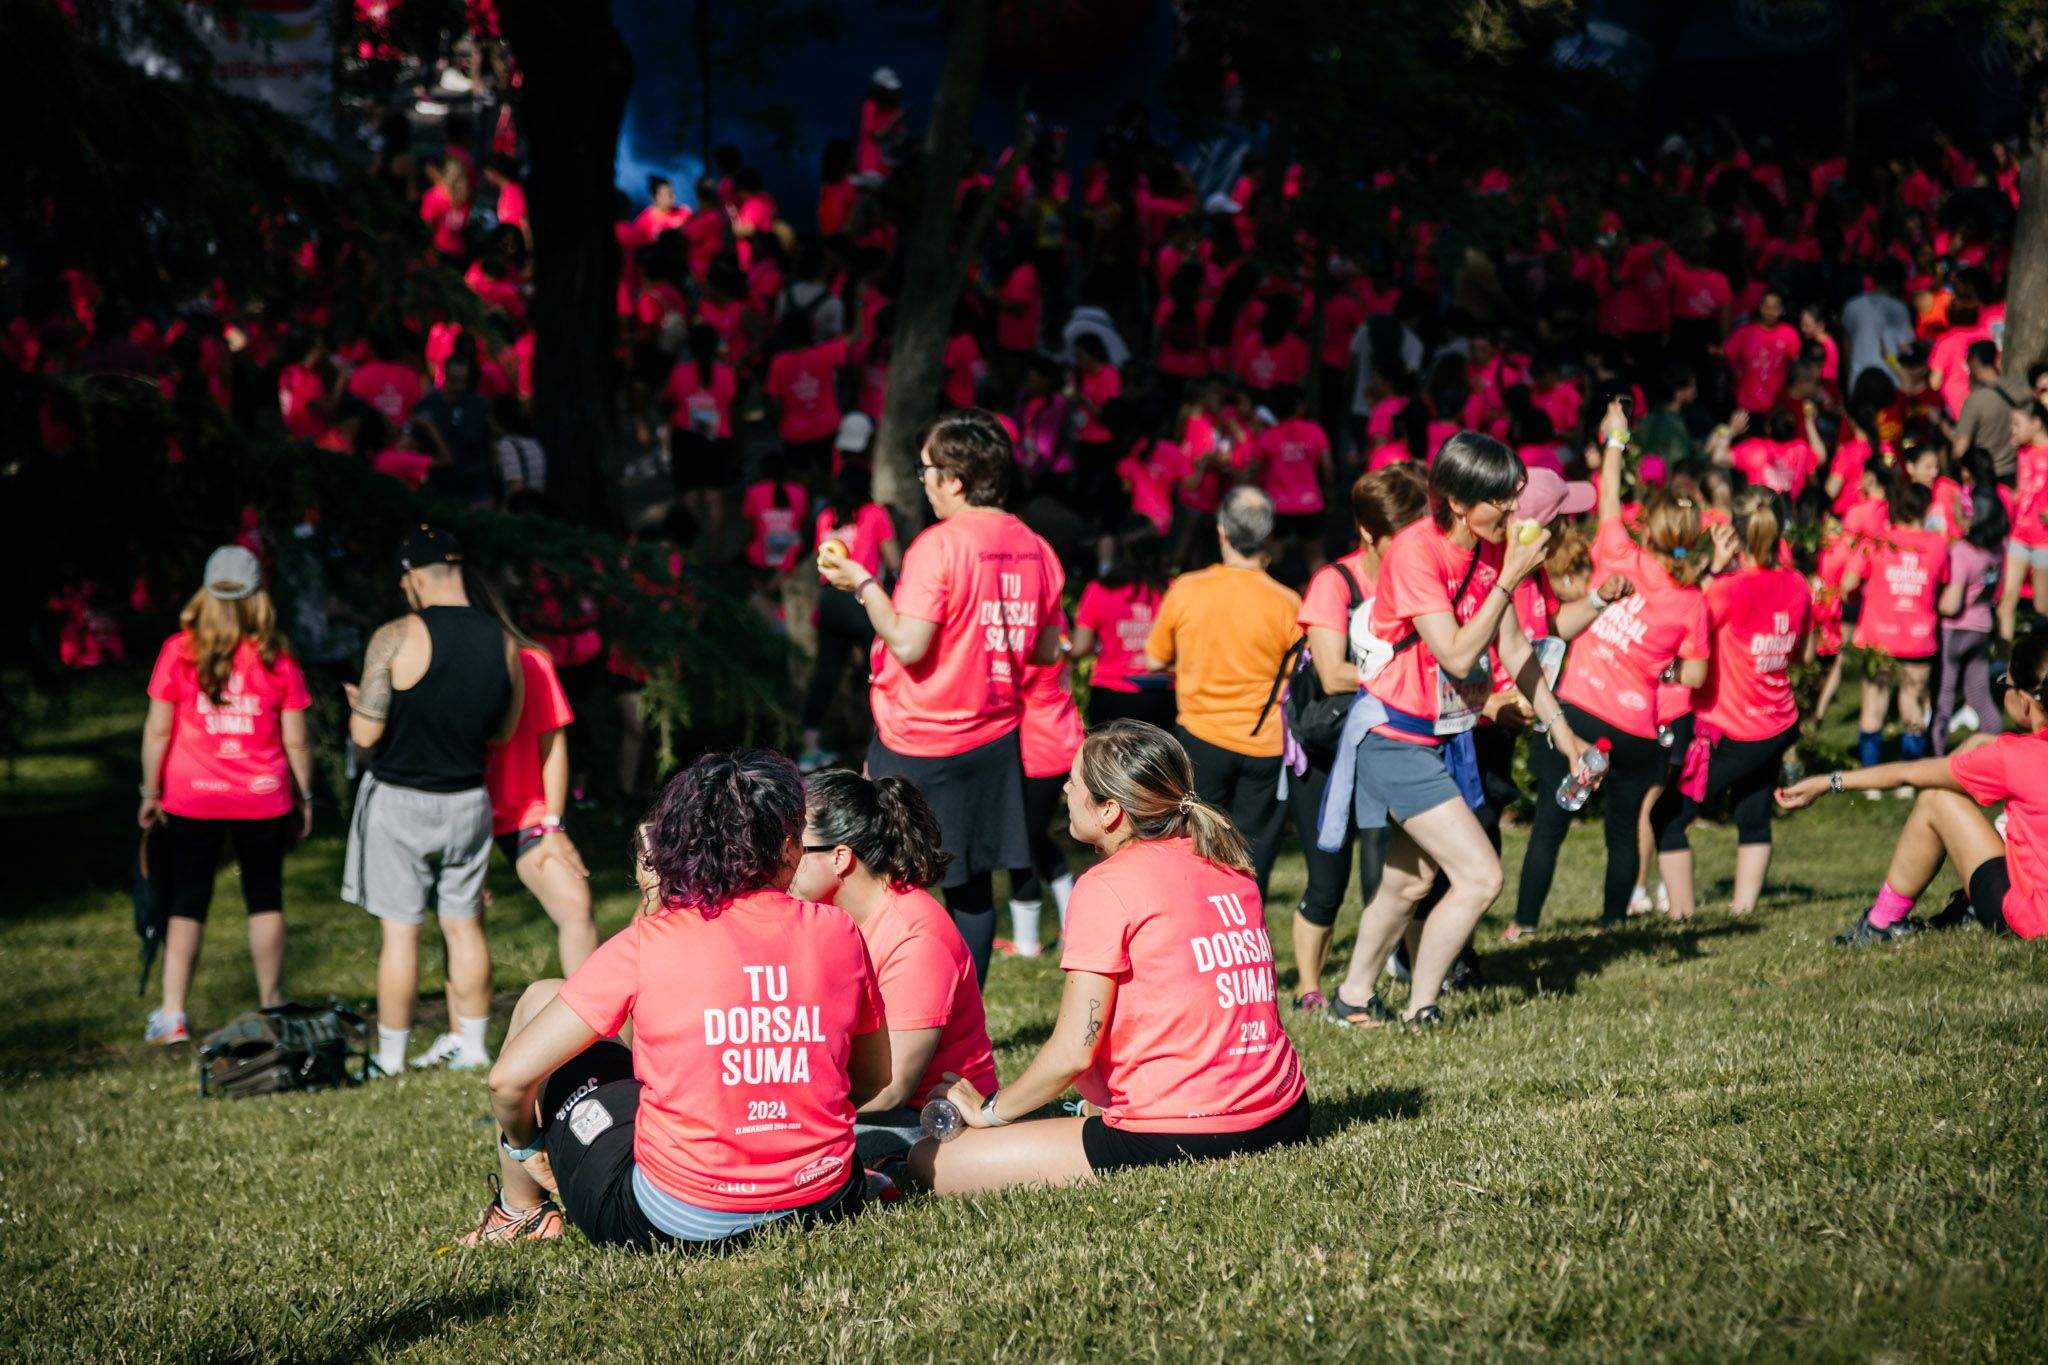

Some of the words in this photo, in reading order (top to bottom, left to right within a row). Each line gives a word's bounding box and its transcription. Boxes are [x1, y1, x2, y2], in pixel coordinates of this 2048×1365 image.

[1000, 572, 1022, 600] TU
[1773, 610, 1789, 634] TU
[1207, 892, 1248, 928] TU
[742, 965, 789, 1002] TU
[703, 1005, 827, 1046] DORSAL
[1240, 1019, 1267, 1043] 2024
[721, 1047, 811, 1086] SUMA
[747, 1100, 788, 1121] 2024
